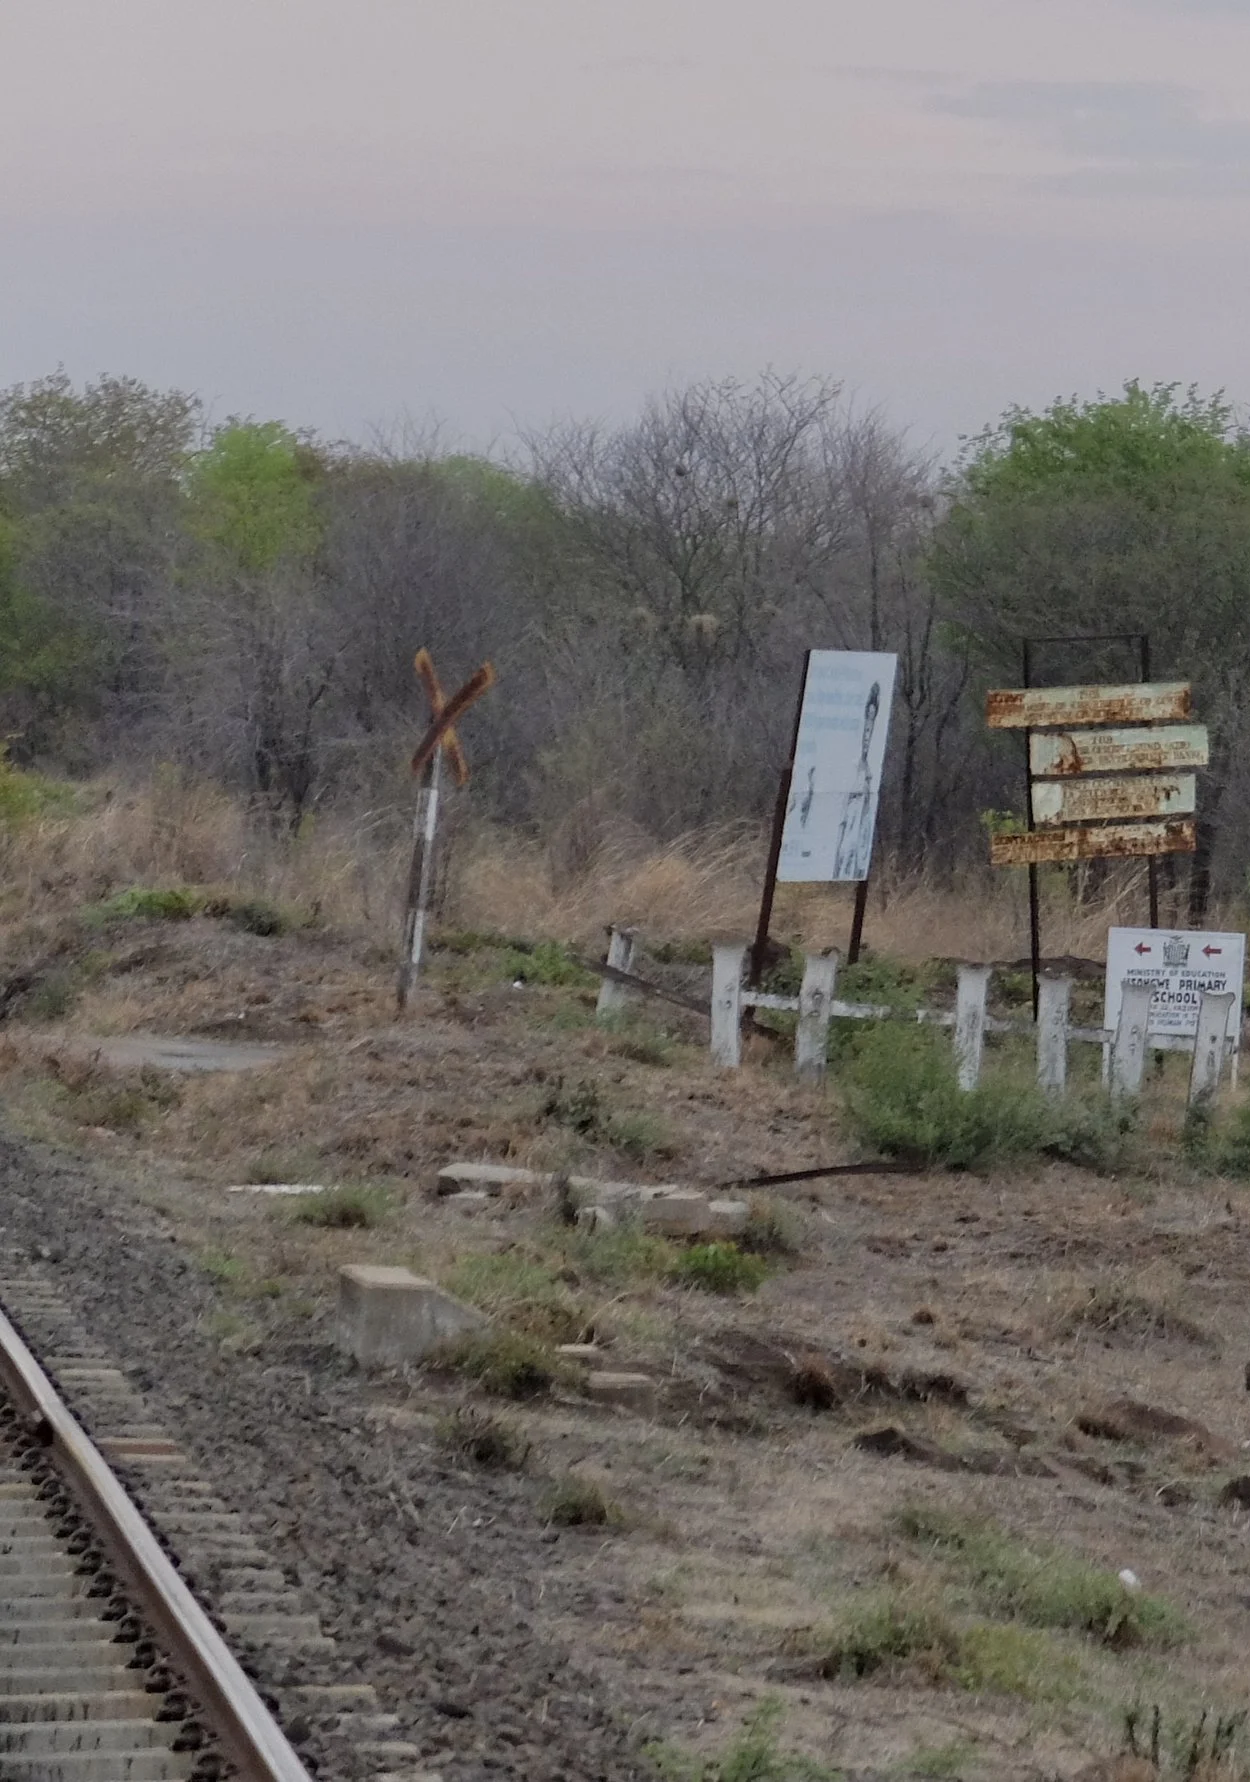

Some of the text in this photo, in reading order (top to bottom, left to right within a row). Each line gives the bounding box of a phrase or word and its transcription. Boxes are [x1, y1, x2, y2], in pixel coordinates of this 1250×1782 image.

[1126, 968, 1226, 978] MINISTRY OF EDUCATION
[1178, 979, 1227, 992] PRIMARY
[1152, 991, 1198, 1004] SCHOOL
